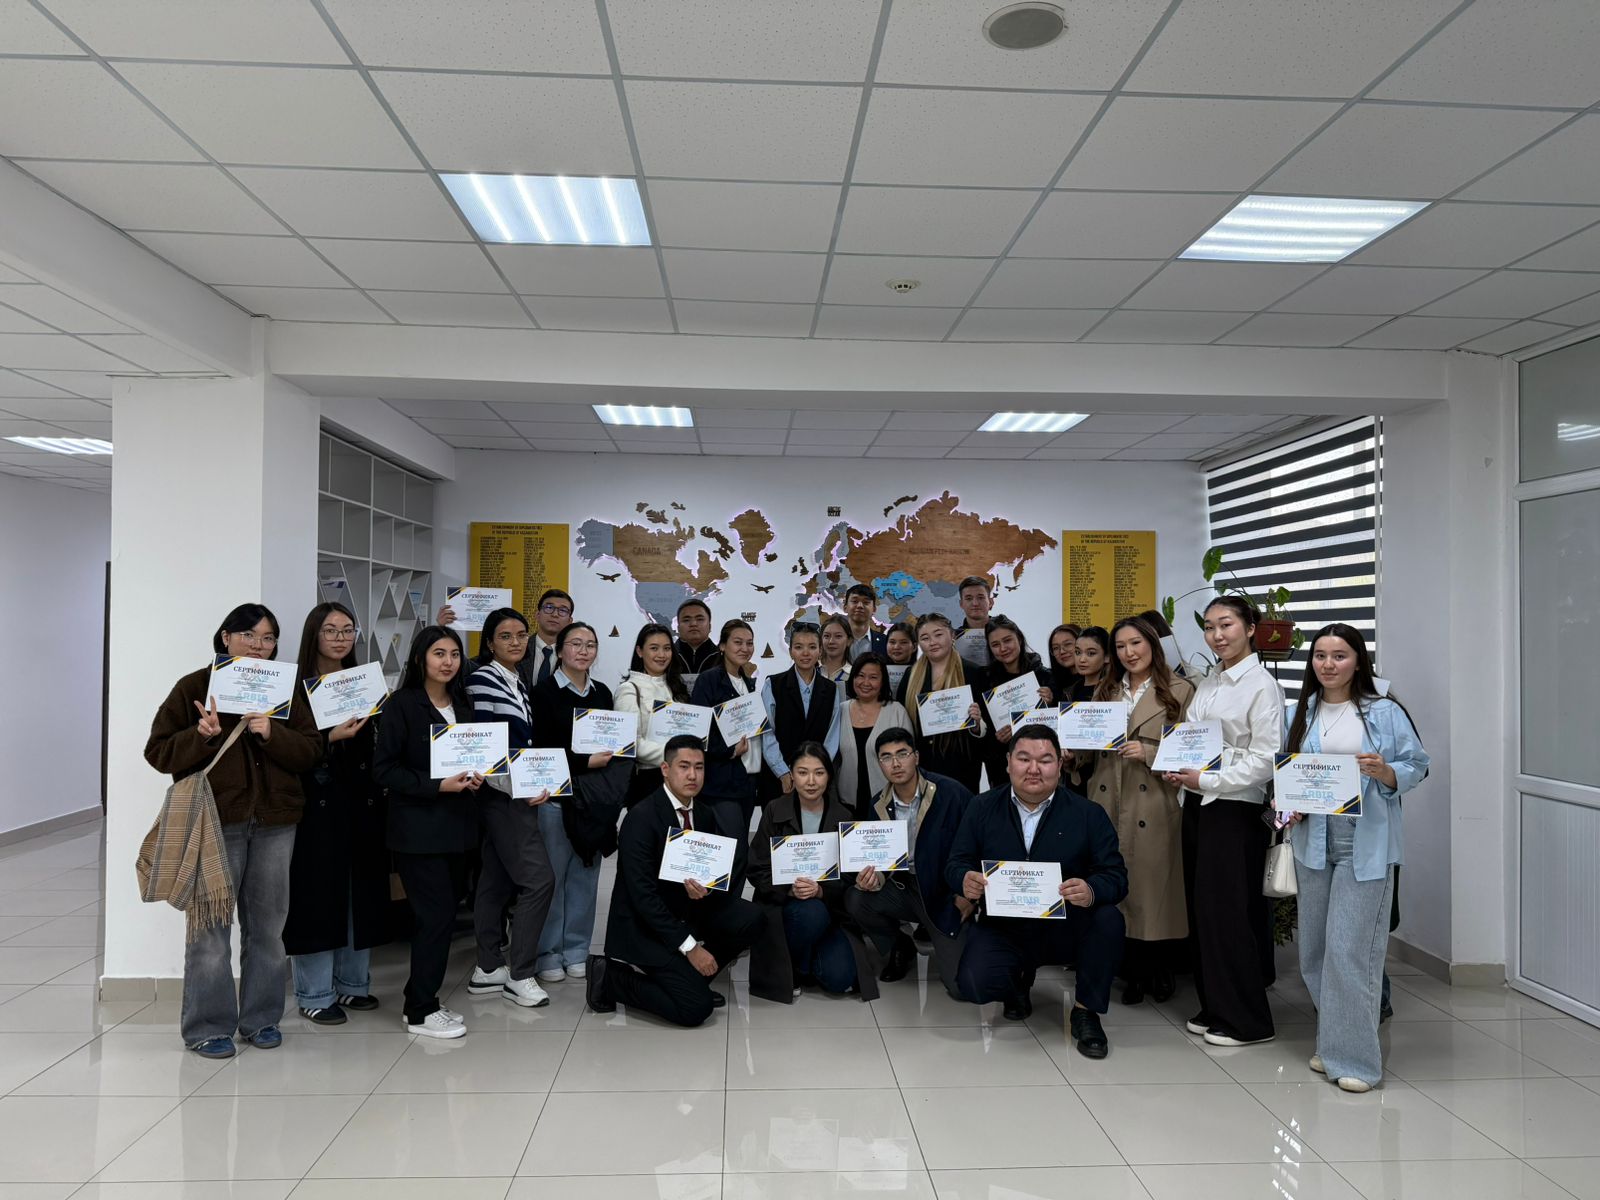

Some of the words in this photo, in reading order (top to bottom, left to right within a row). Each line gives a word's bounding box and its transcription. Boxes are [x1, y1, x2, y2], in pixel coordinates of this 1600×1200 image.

[632, 546, 661, 556] CANADA
[234, 666, 280, 676] СЕРТИФИКАТ
[324, 674, 367, 688] СЕРТИФИКАТ
[996, 682, 1026, 698] СЕРТИФИКАТ
[930, 694, 960, 704] СЕРТИФИКАТ
[725, 701, 752, 714] СЕРТИФИКАТ
[666, 710, 699, 718] СЕРТИФИКАТ
[683, 838, 722, 850] СЕРТИФИКАТ
